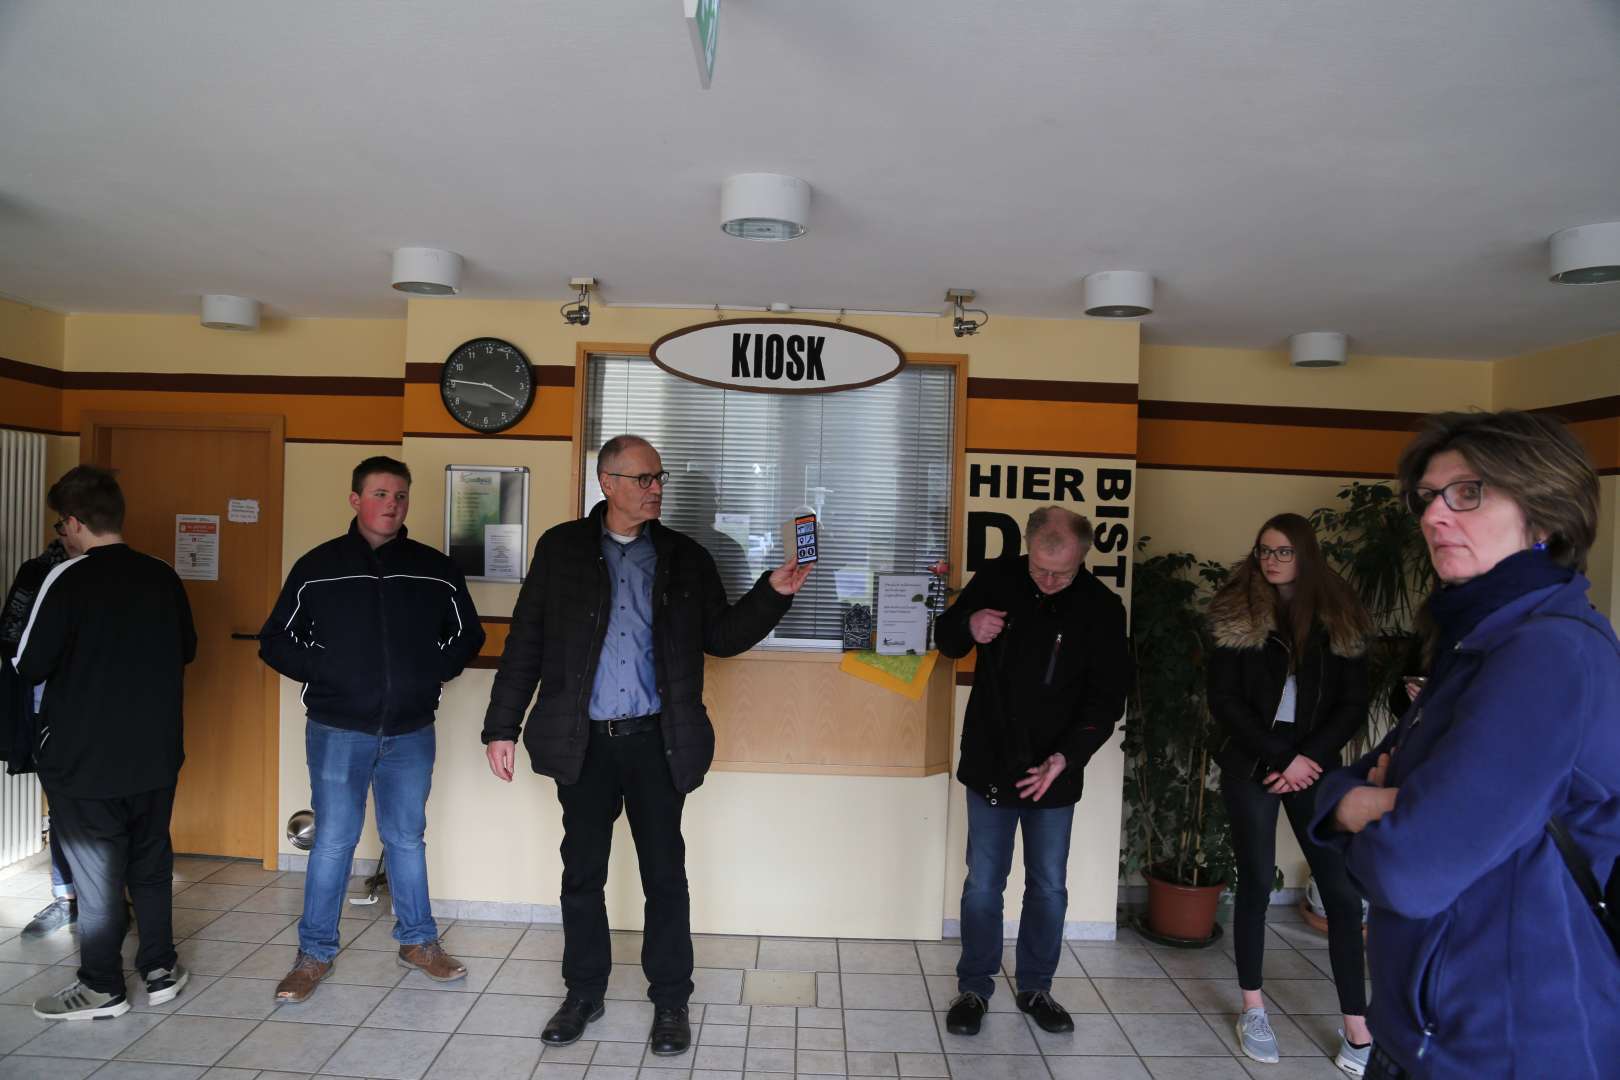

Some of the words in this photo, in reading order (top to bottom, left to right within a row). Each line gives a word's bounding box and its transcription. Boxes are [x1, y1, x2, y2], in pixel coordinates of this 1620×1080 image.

[732, 333, 825, 381] KIOSK
[970, 464, 1085, 502] HIER
[966, 511, 1022, 572] D
[1092, 468, 1131, 588] BIST
